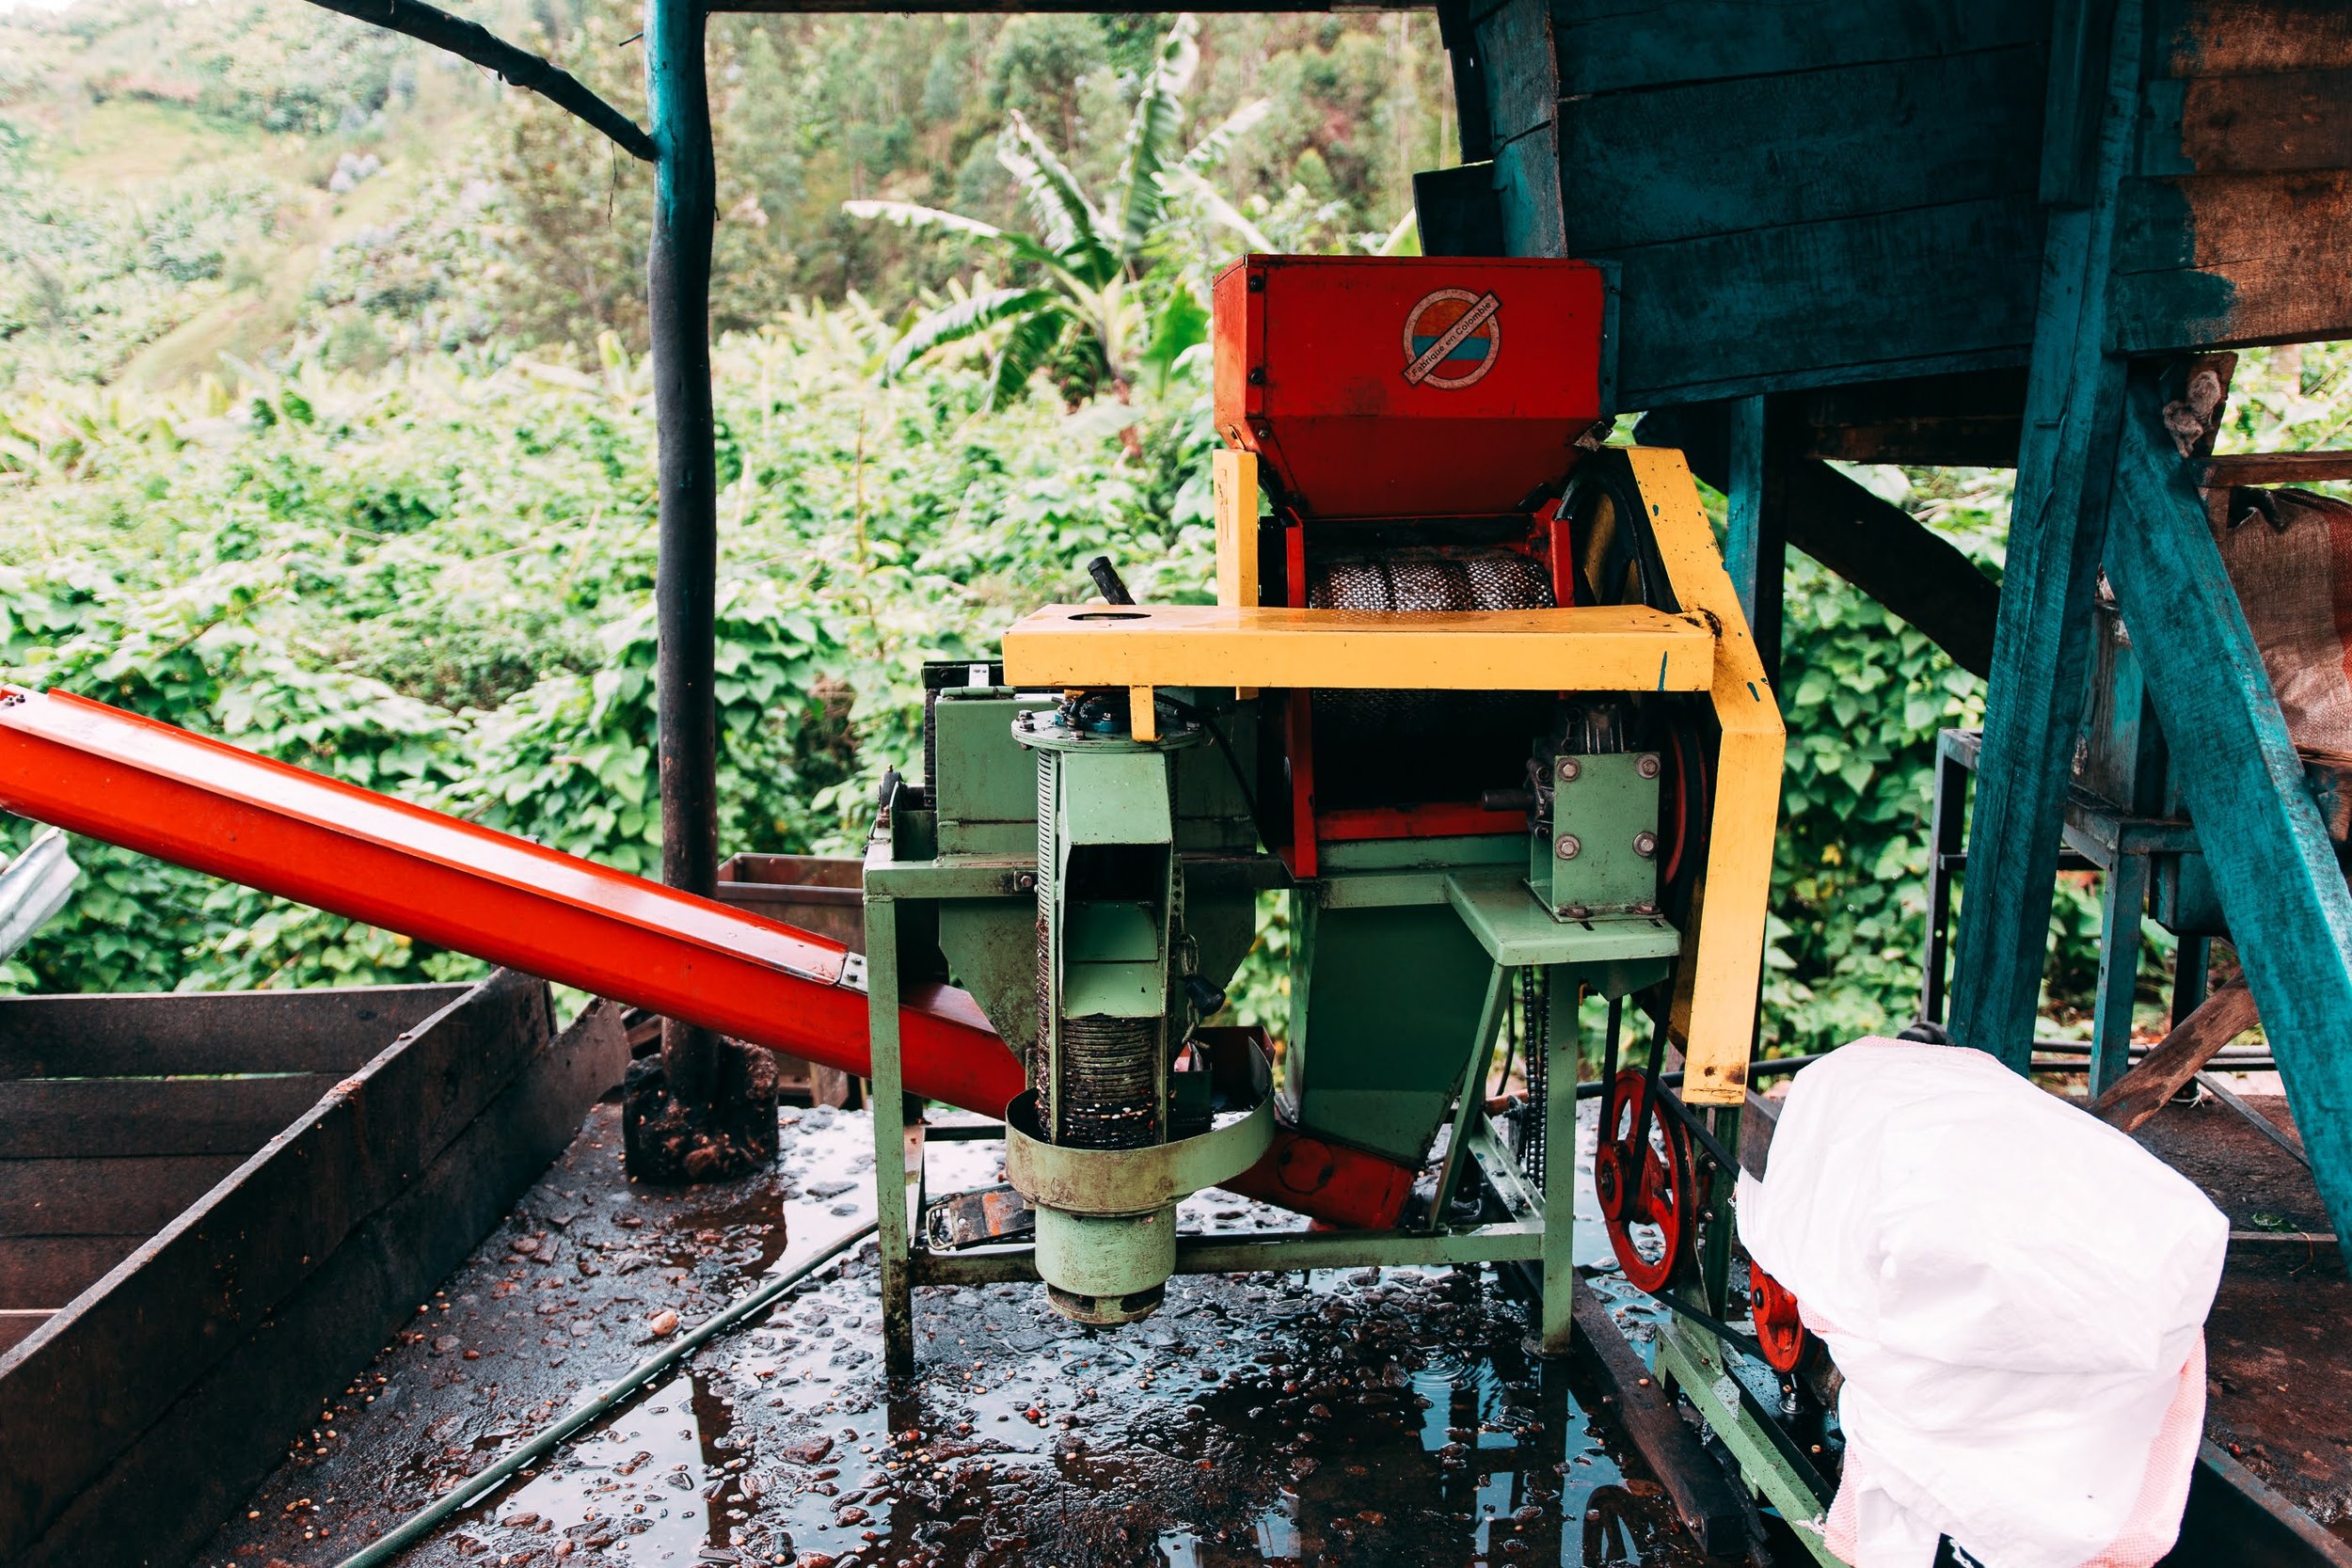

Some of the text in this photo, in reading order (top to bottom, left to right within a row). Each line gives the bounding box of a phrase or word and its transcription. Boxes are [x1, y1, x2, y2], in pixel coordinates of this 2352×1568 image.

[1411, 302, 1491, 376] Fabriqué en Colombie
